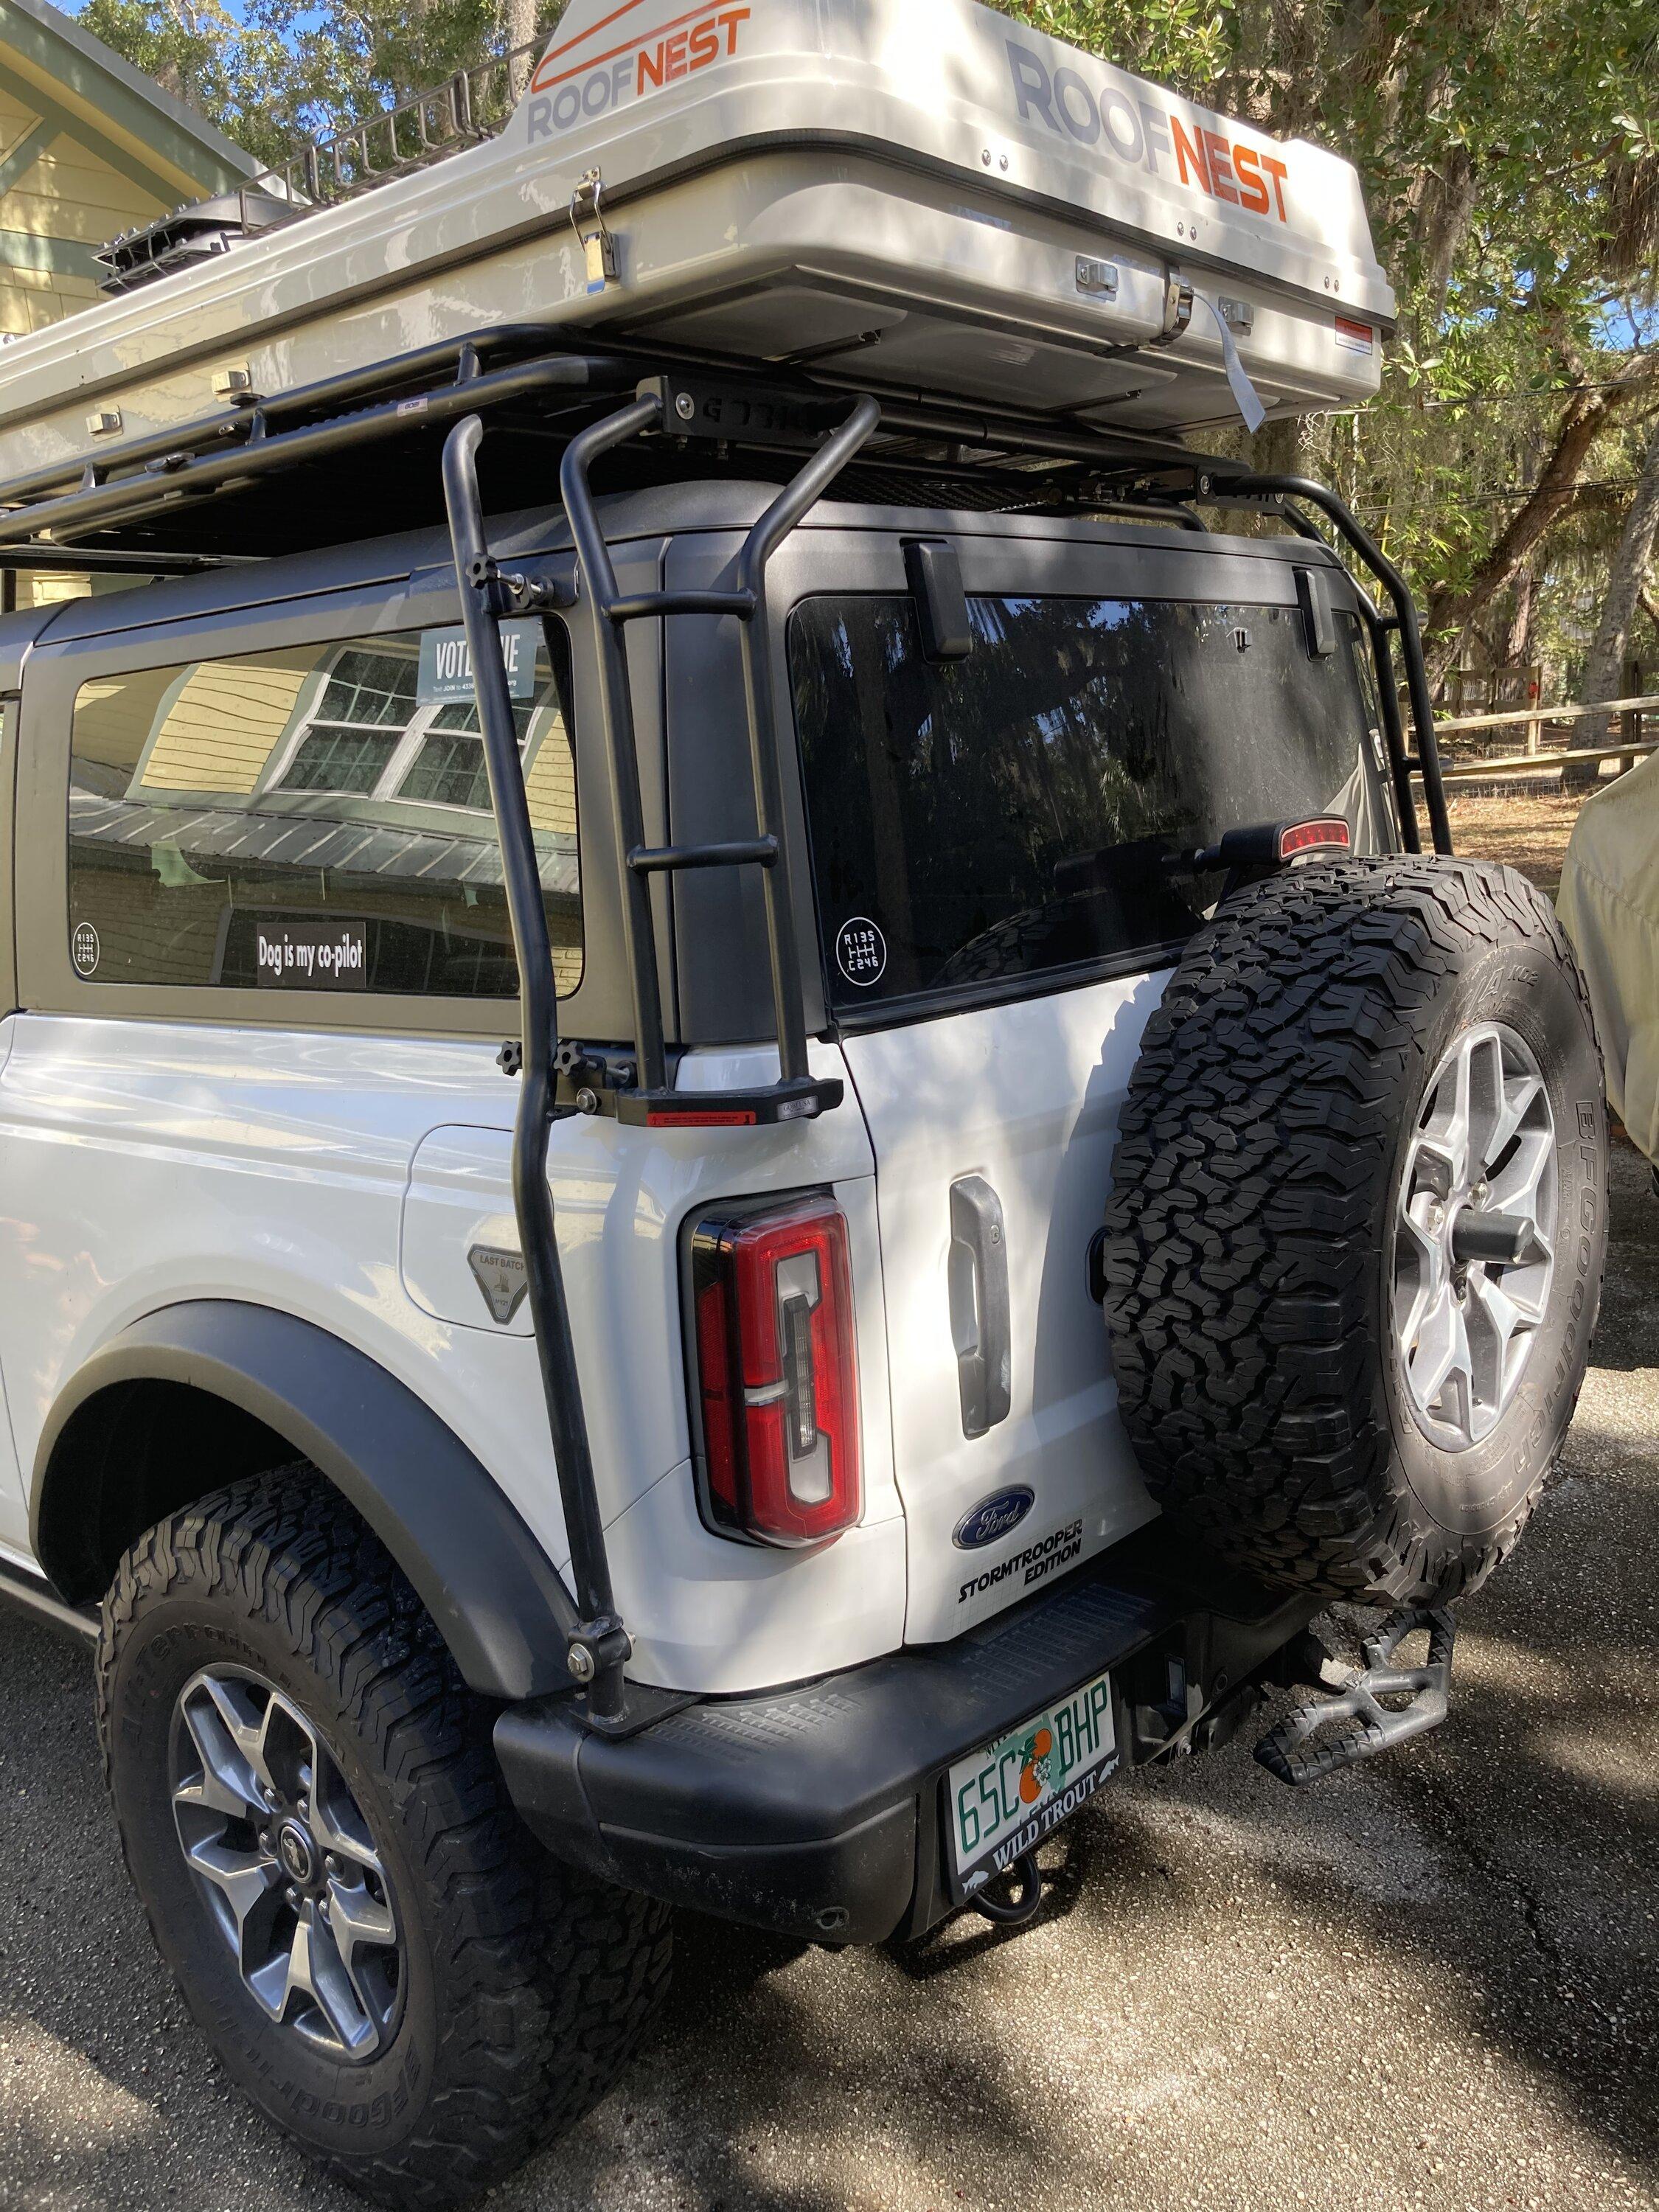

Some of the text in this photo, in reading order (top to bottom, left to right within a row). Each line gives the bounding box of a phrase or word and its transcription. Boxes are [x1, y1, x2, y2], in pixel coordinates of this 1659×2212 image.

[526, 7, 751, 145] ROOFNEST
[1004, 38, 1289, 223] ROOFNEST
[443, 684, 456, 692] JOIN
[259, 933, 363, 978] Dog is my co-pilot
[479, 1254, 500, 1267] LAST
[975, 1500, 1021, 1542] Ford
[958, 1517, 1084, 1604] STORMTROOPER
[1023, 1537, 1082, 1586] EDITION
[1054, 1680, 1107, 1778] BHP
[992, 1820, 1040, 1871] WILD
[1040, 1770, 1098, 1832] TROUT
